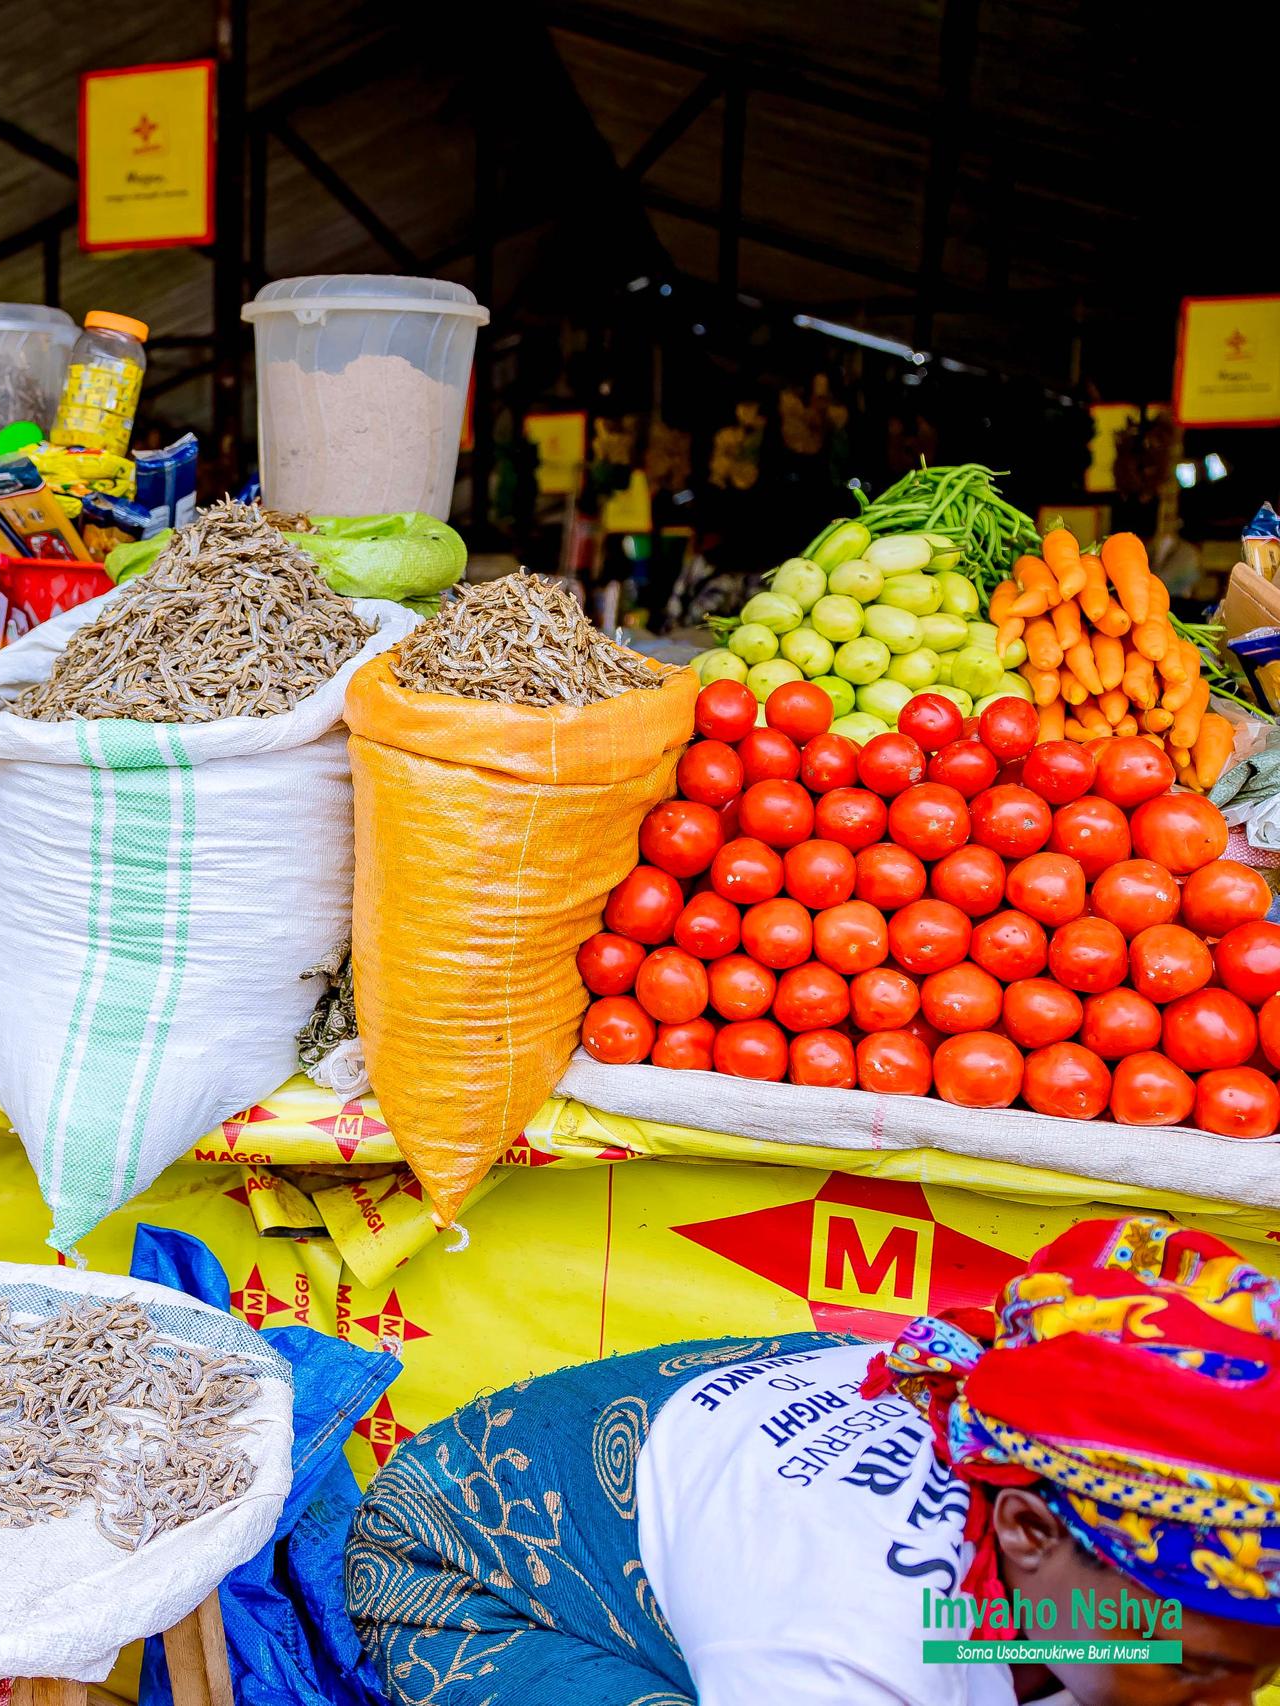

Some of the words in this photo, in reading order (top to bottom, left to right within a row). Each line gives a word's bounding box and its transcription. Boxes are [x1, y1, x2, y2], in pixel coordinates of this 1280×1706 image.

[338, 1117, 358, 1135] M
[194, 1149, 272, 1164] MAGGI
[506, 1149, 531, 1165] M
[348, 1182, 385, 1235] MAGGI
[824, 1216, 919, 1298] M
[247, 1293, 264, 1311] M
[294, 1272, 310, 1324] AGGI
[336, 1284, 353, 1342] MAG
[382, 1318, 401, 1337] M
[690, 1353, 823, 1412] TWINKLE
[768, 1373, 816, 1392] TO
[374, 1420, 392, 1440] M
[759, 1389, 850, 1449] RIGHT
[777, 1402, 909, 1487] DESERVES
